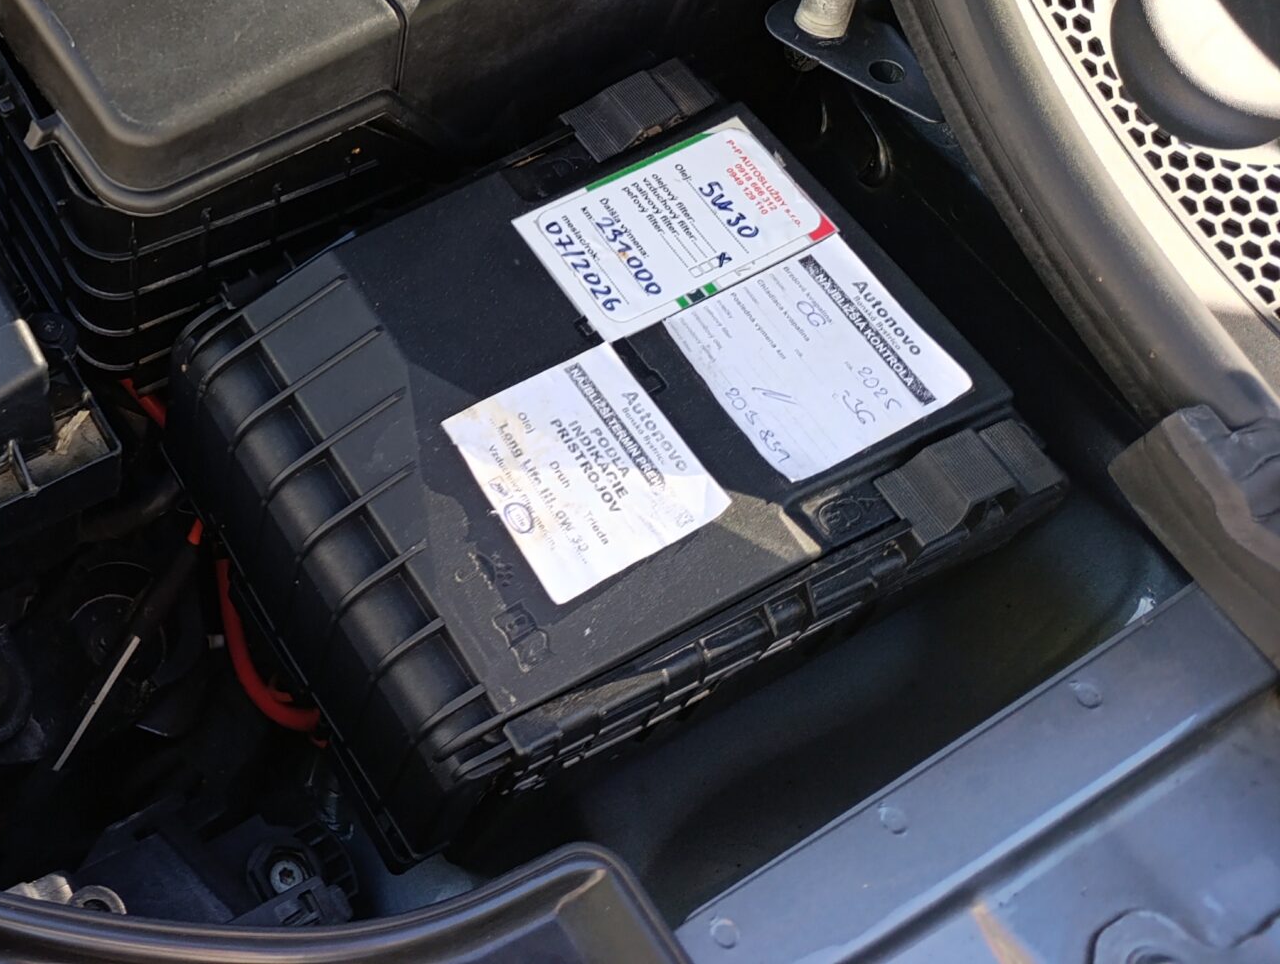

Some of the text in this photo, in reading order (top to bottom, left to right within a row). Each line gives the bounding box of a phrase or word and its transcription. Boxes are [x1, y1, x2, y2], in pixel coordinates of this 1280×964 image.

[651, 173, 678, 201] olejový
[725, 139, 742, 154] P+P
[739, 155, 787, 206] AUTOSLUŽBY
[726, 167, 768, 214] 0949 129 110
[734, 163, 752, 181] 0918
[761, 196, 777, 210] 312
[599, 197, 621, 223] Ďalšia
[630, 181, 662, 214] palivový
[642, 177, 680, 219] vzduchový
[544, 221, 621, 311] 07/2026
[852, 281, 920, 355] Autonovo
[861, 328, 917, 386] KONTROLA
[498, 422, 523, 458] Long
[517, 411, 536, 434] Olej
[548, 460, 570, 488] Druh
[621, 391, 687, 471] Autonovo
